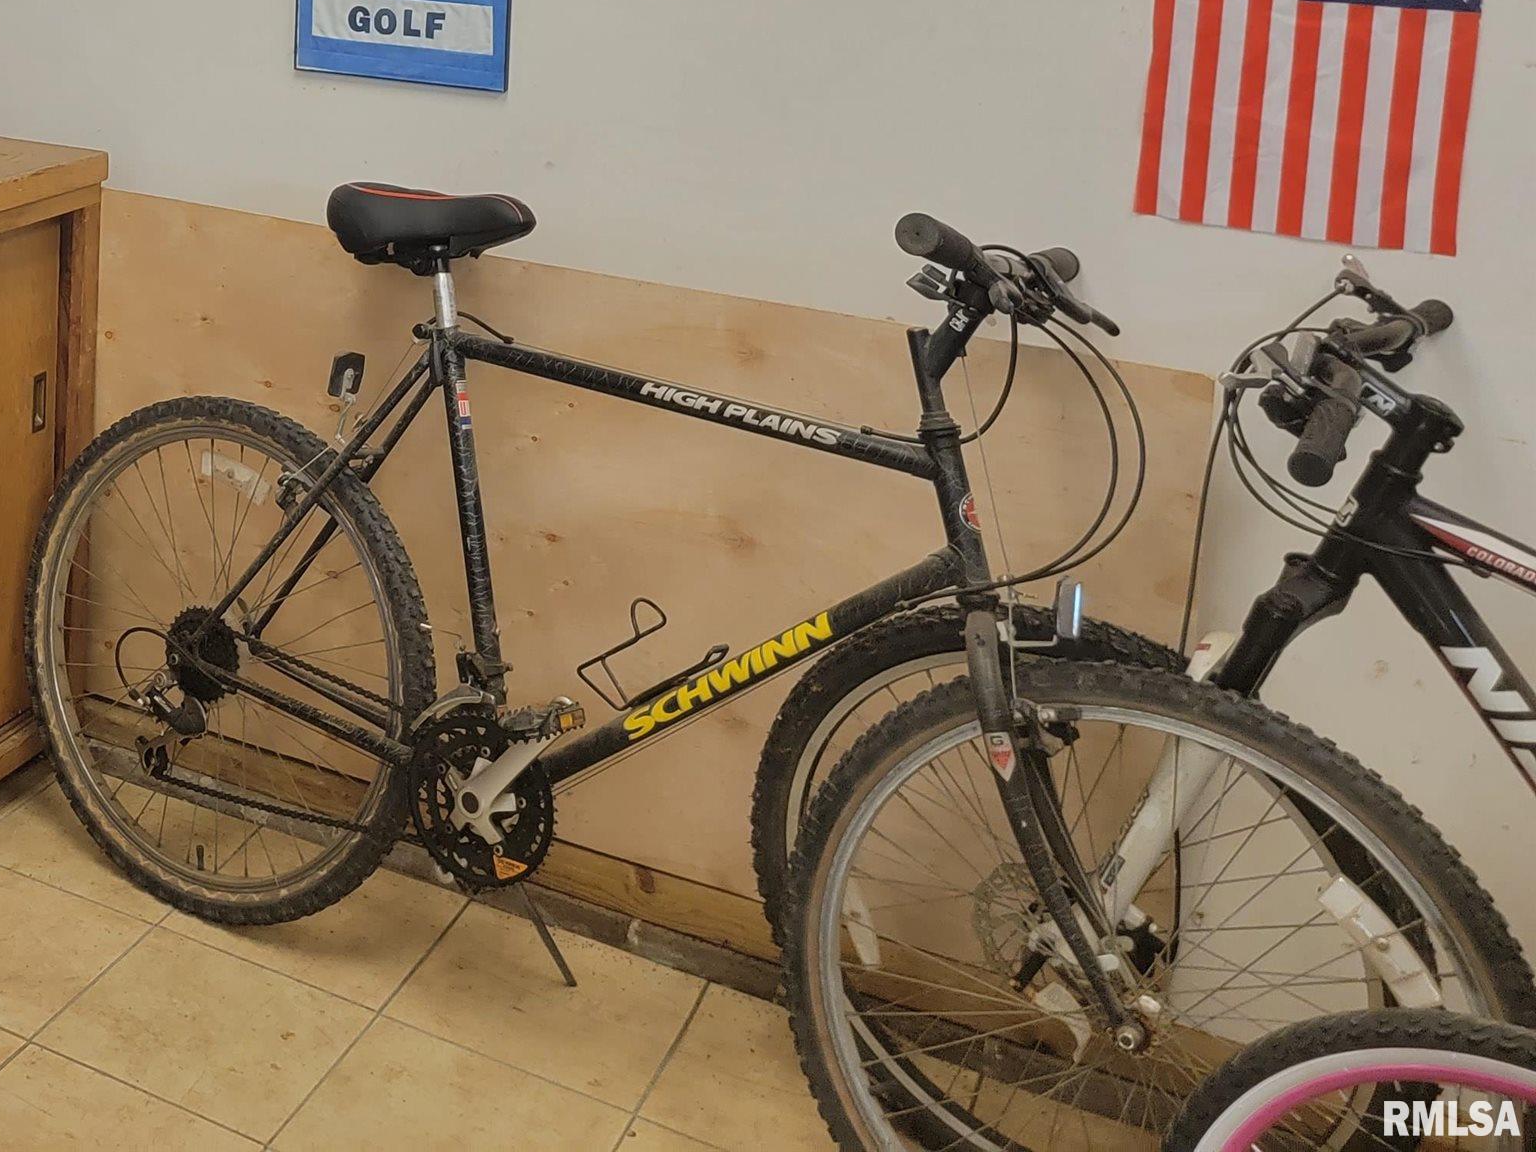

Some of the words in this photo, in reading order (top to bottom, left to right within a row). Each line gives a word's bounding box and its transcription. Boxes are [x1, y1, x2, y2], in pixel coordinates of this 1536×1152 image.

[347, 6, 447, 40] GOLF
[639, 382, 723, 415] HIGH
[723, 404, 841, 445] PLAINS
[623, 611, 833, 740] SCHWINN
